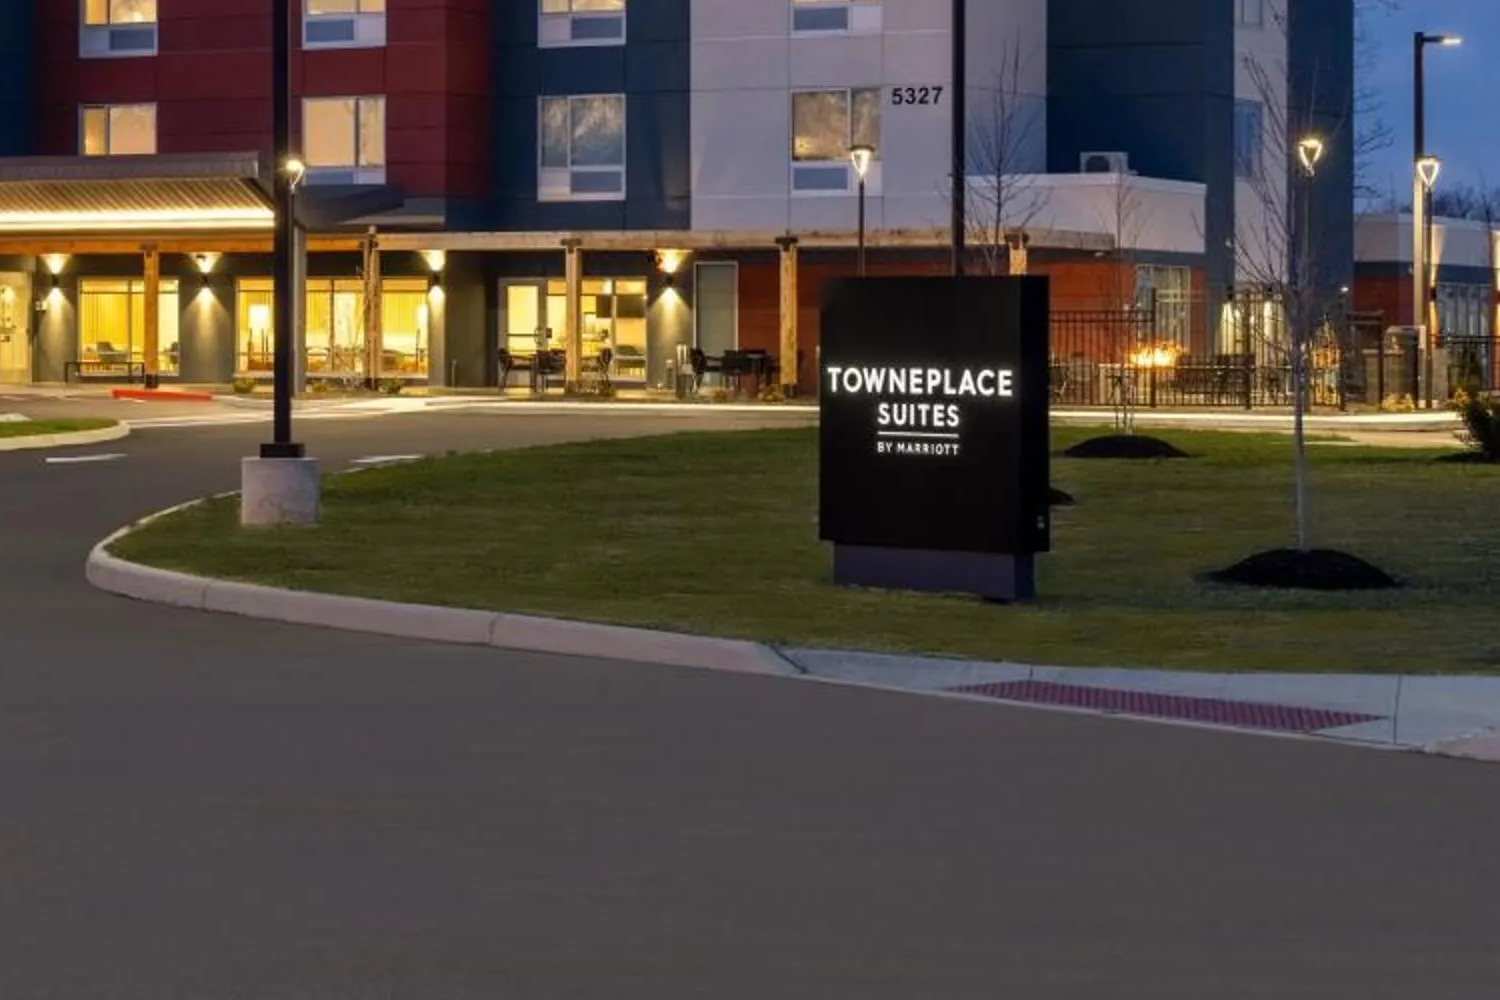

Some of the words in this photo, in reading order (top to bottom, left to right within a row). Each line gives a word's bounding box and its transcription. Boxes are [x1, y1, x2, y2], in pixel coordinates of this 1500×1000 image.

[891, 86, 943, 105] 5327
[827, 366, 1013, 397] TOWNEPLACE
[877, 402, 960, 427] SUITES
[877, 441, 893, 453] BY
[896, 442, 959, 456] MARRIOTT
